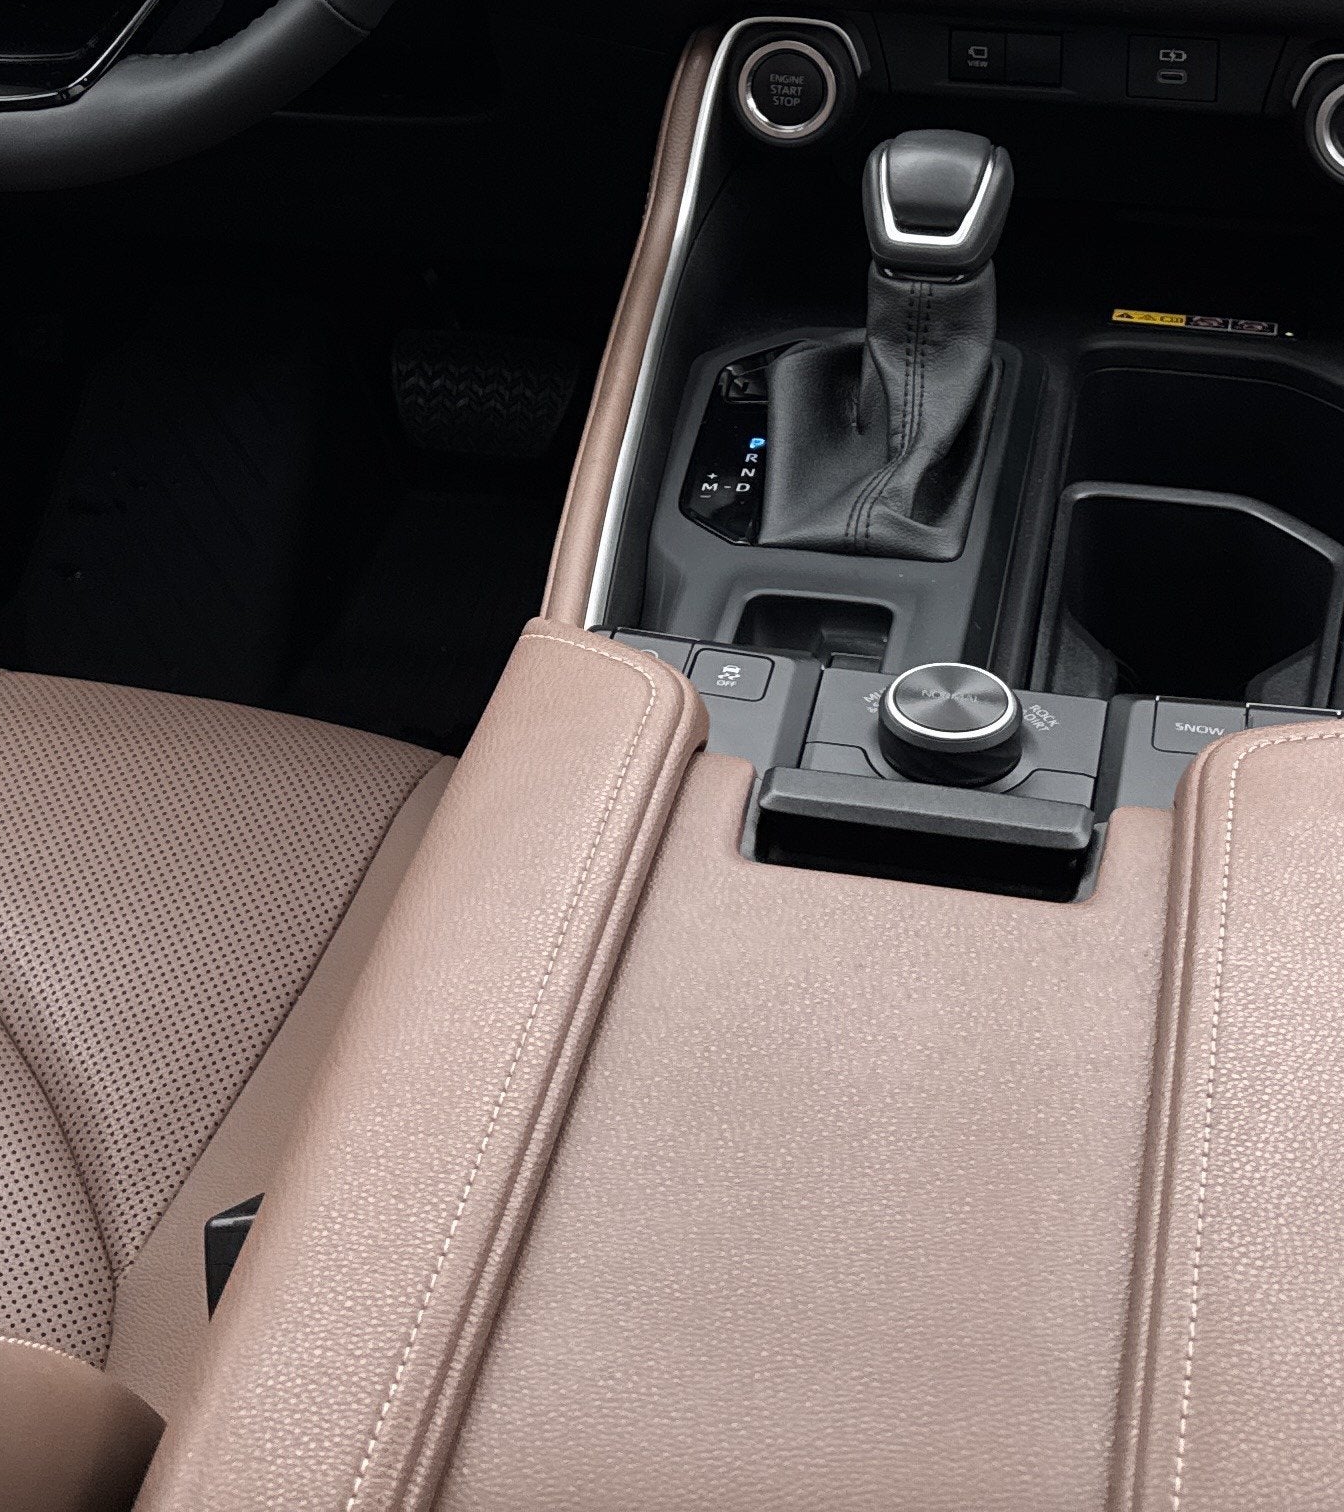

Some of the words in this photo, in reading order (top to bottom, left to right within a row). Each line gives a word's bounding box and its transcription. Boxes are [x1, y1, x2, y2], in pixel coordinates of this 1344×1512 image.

[967, 59, 988, 68] VIEW
[769, 73, 805, 85] ENGINE
[770, 85, 803, 96] START
[773, 96, 801, 107] STOP
[749, 437, 766, 449] P
[744, 453, 759, 463] R
[740, 468, 756, 477] N
[701, 482, 719, 492] M
[735, 482, 751, 492] D
[716, 679, 738, 688] OFF
[1028, 704, 1060, 728] ROCK
[1174, 721, 1226, 737] SNOW
